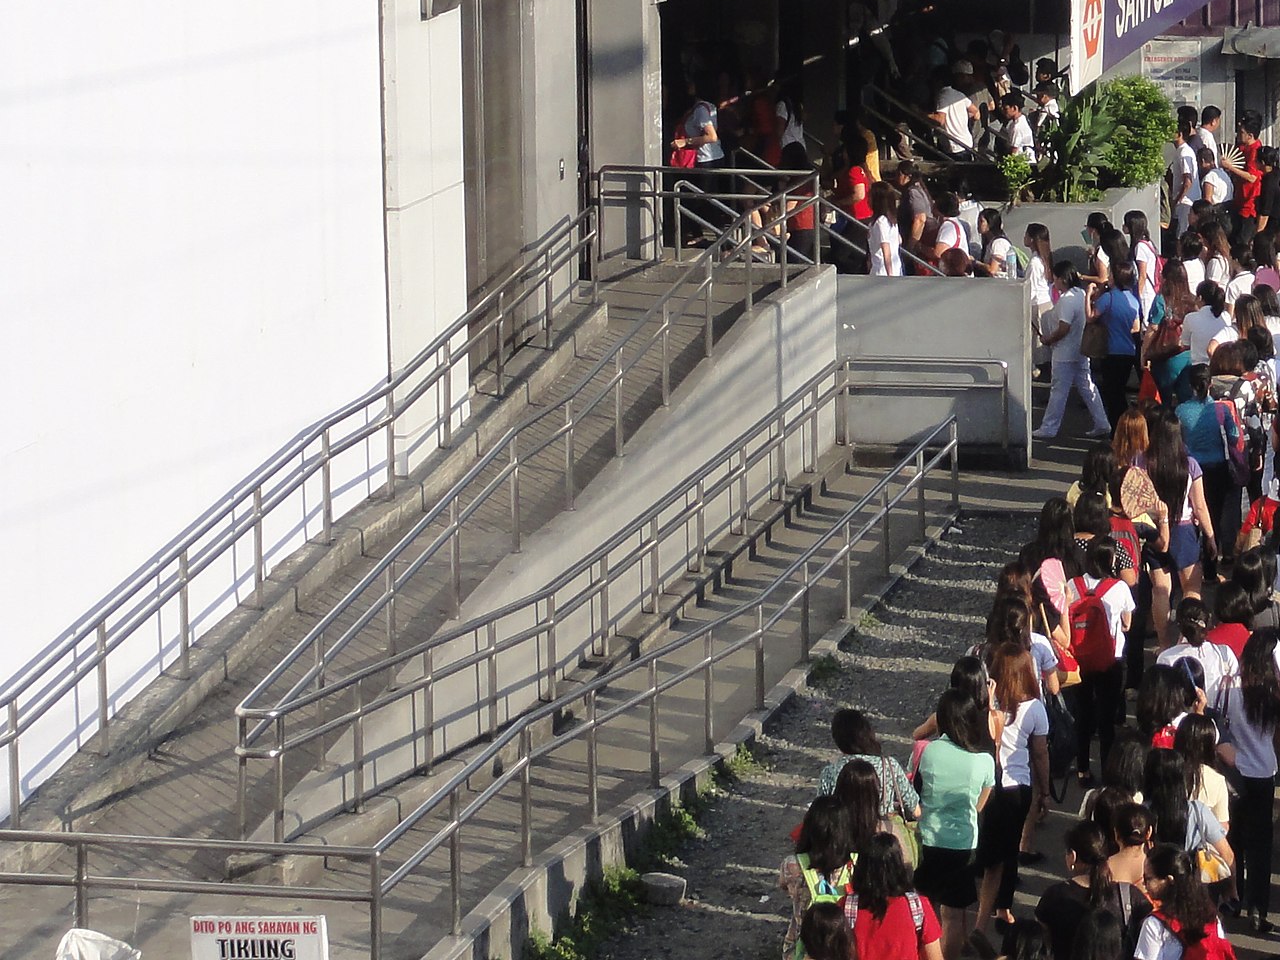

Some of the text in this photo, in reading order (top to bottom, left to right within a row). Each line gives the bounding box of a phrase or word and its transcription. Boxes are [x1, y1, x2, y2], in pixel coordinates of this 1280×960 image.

[193, 920, 215, 934] DITO
[218, 921, 232, 935] PO
[235, 921, 255, 934] ANG
[303, 923, 317, 935] NG
[217, 938, 295, 959] TIKLING
